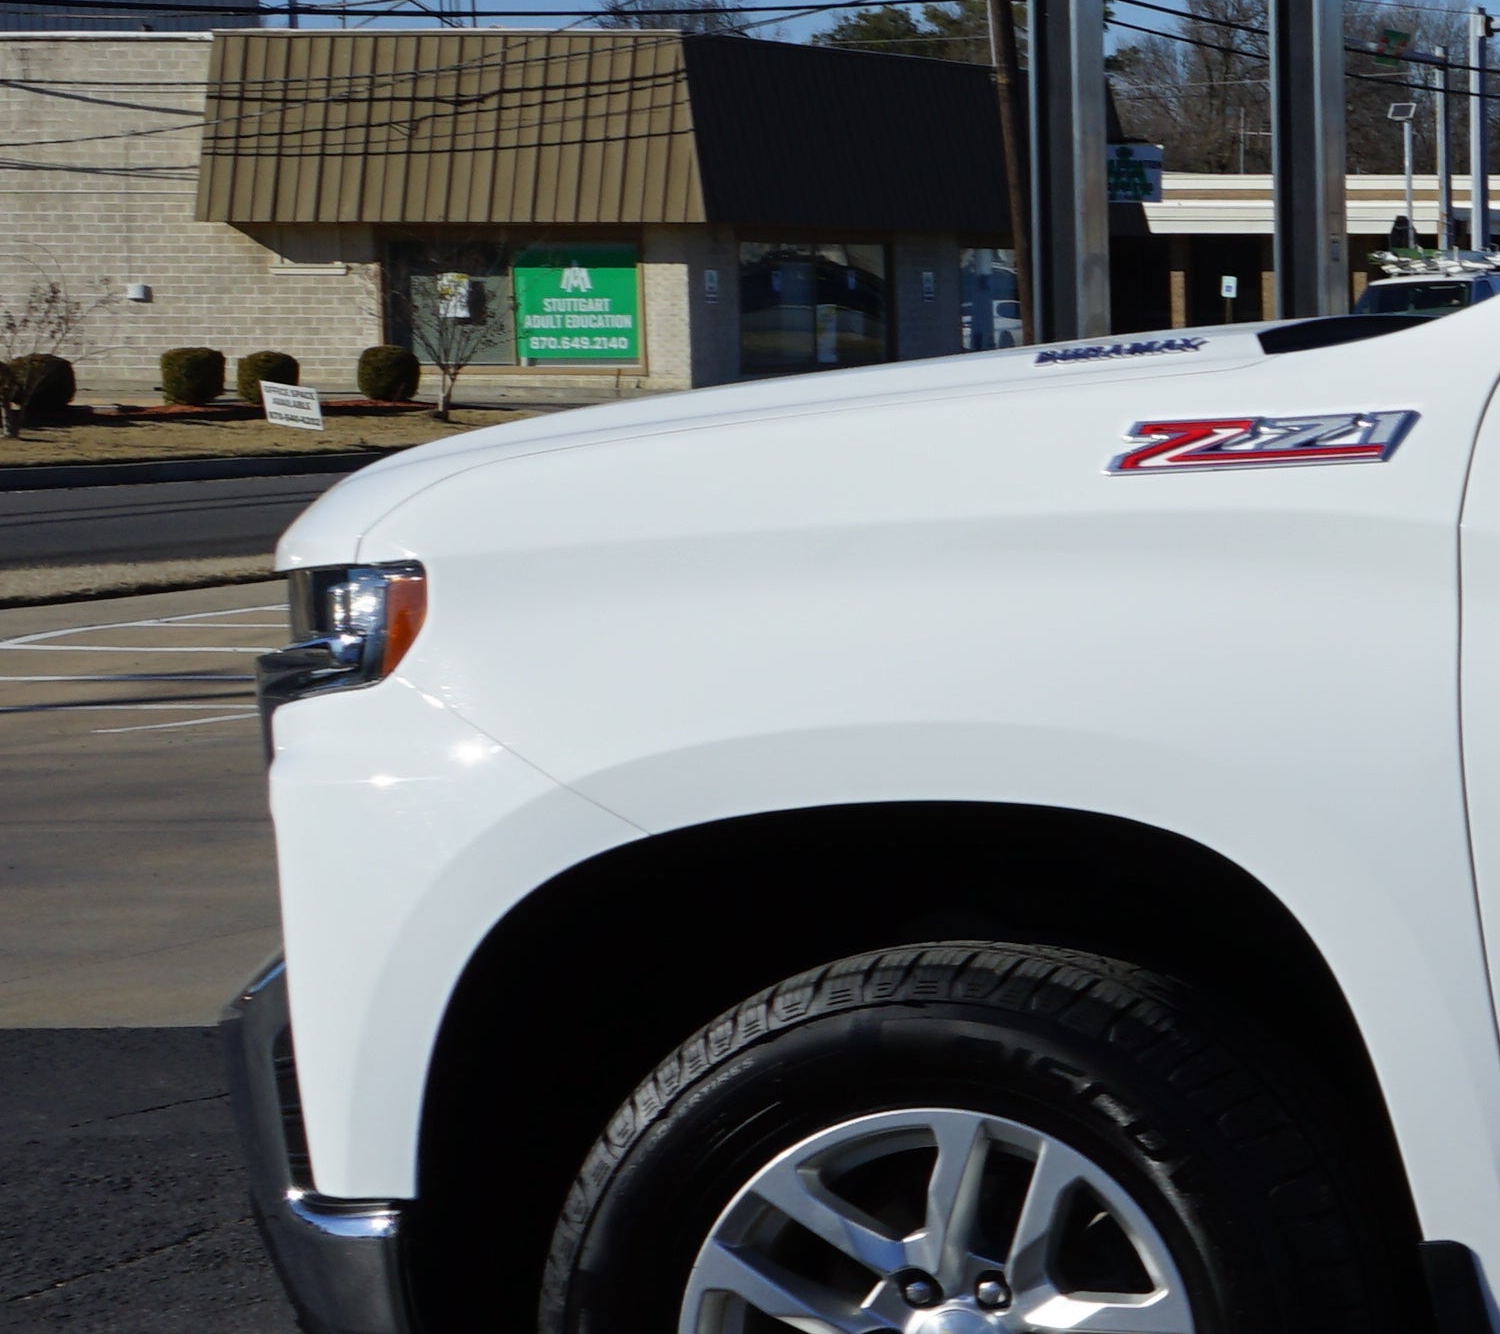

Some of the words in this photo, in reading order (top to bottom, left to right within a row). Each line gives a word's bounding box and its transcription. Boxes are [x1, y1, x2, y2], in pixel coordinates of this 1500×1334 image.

[542, 297, 612, 313] STUTTGART
[524, 314, 563, 329] ADULT
[565, 314, 633, 329] EDUCATION
[529, 336, 629, 350] 870.649.2140
[1101, 410, 1421, 477] Z71
